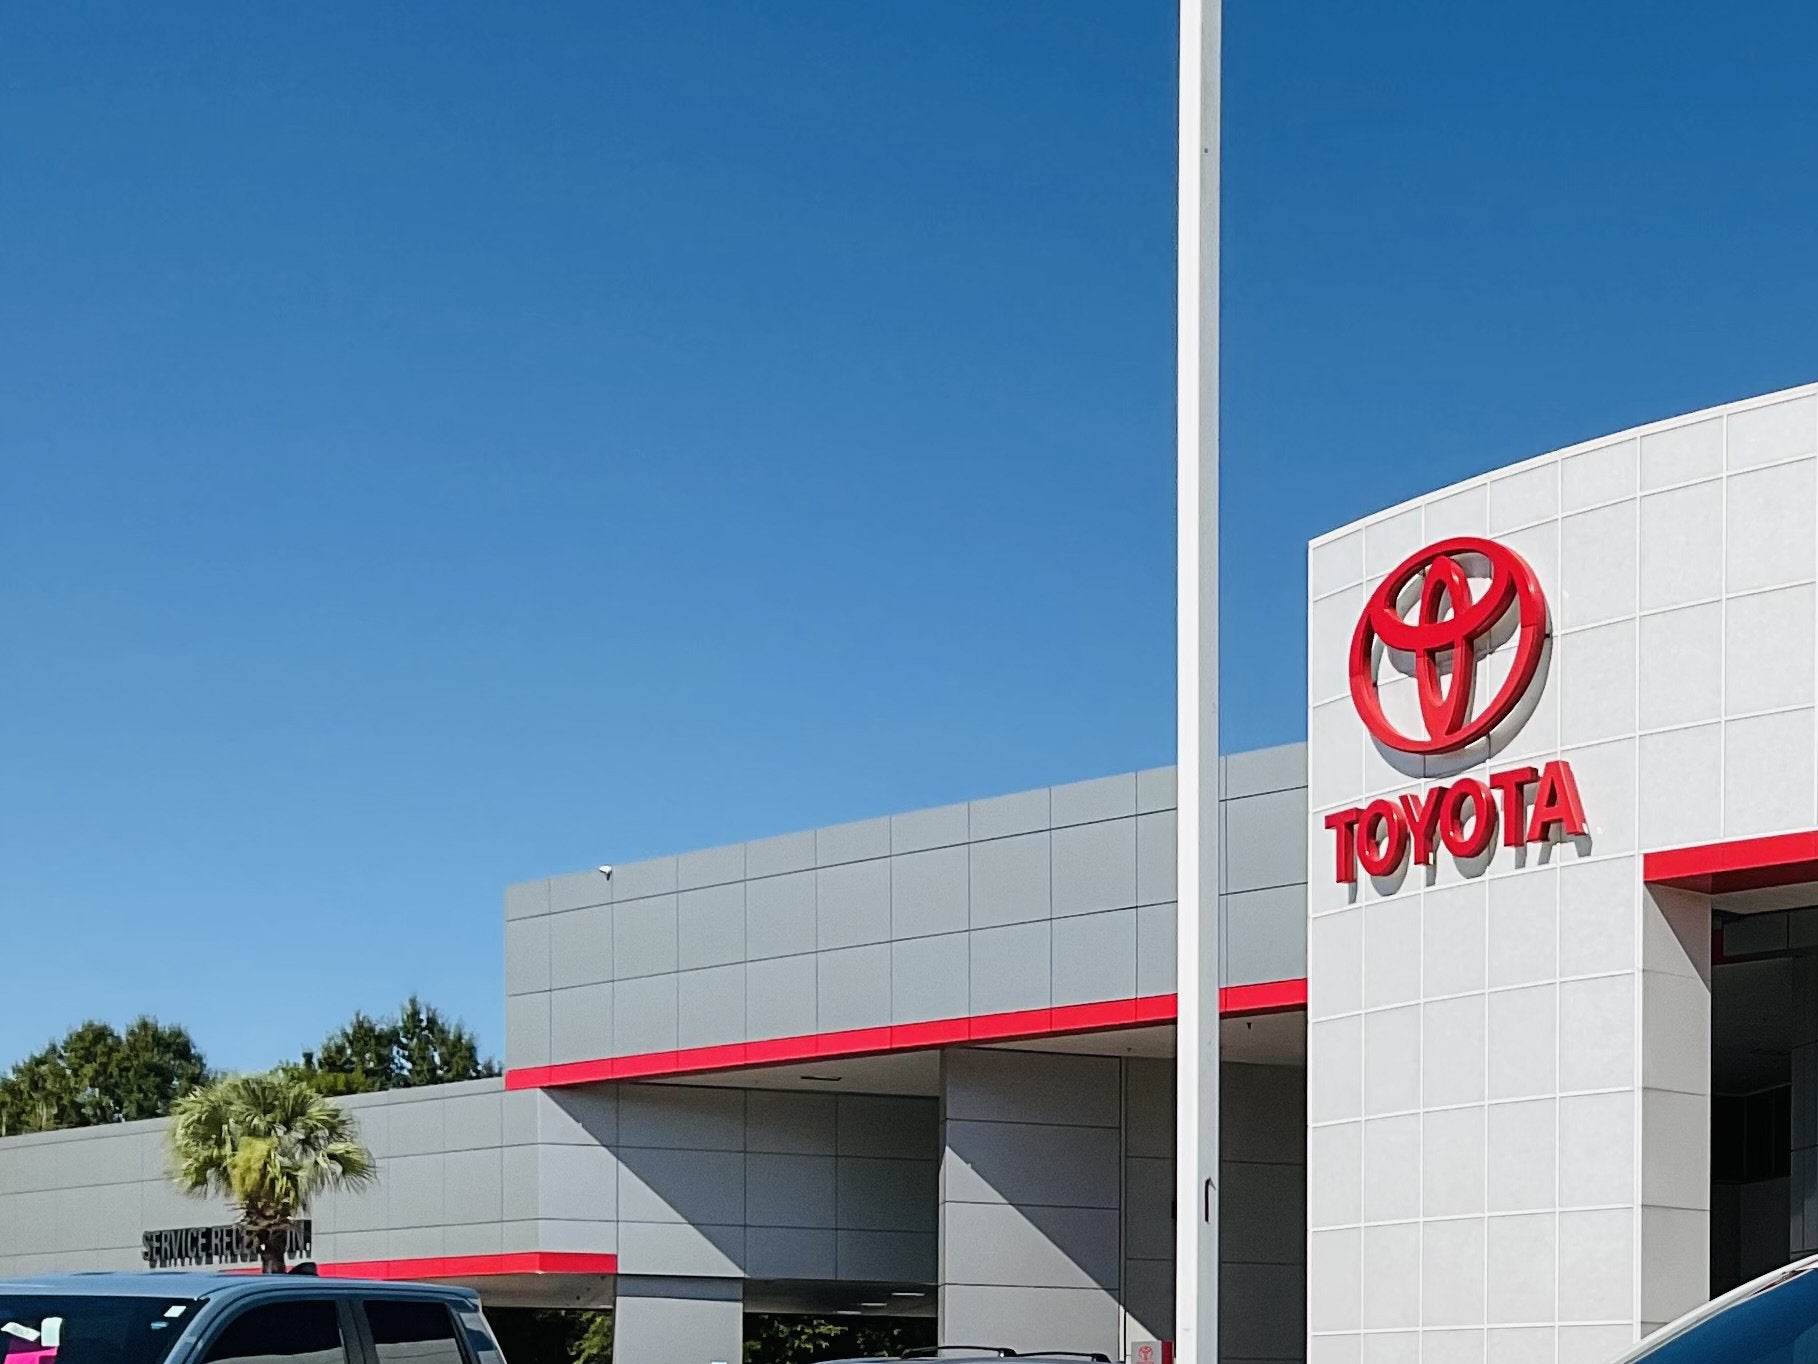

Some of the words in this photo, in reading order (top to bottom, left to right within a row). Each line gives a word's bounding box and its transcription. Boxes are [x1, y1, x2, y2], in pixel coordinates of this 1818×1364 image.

[1325, 760, 1588, 883] TOYOTA
[142, 1226, 208, 1264] SERVICE
[210, 1219, 312, 1258] RECON
